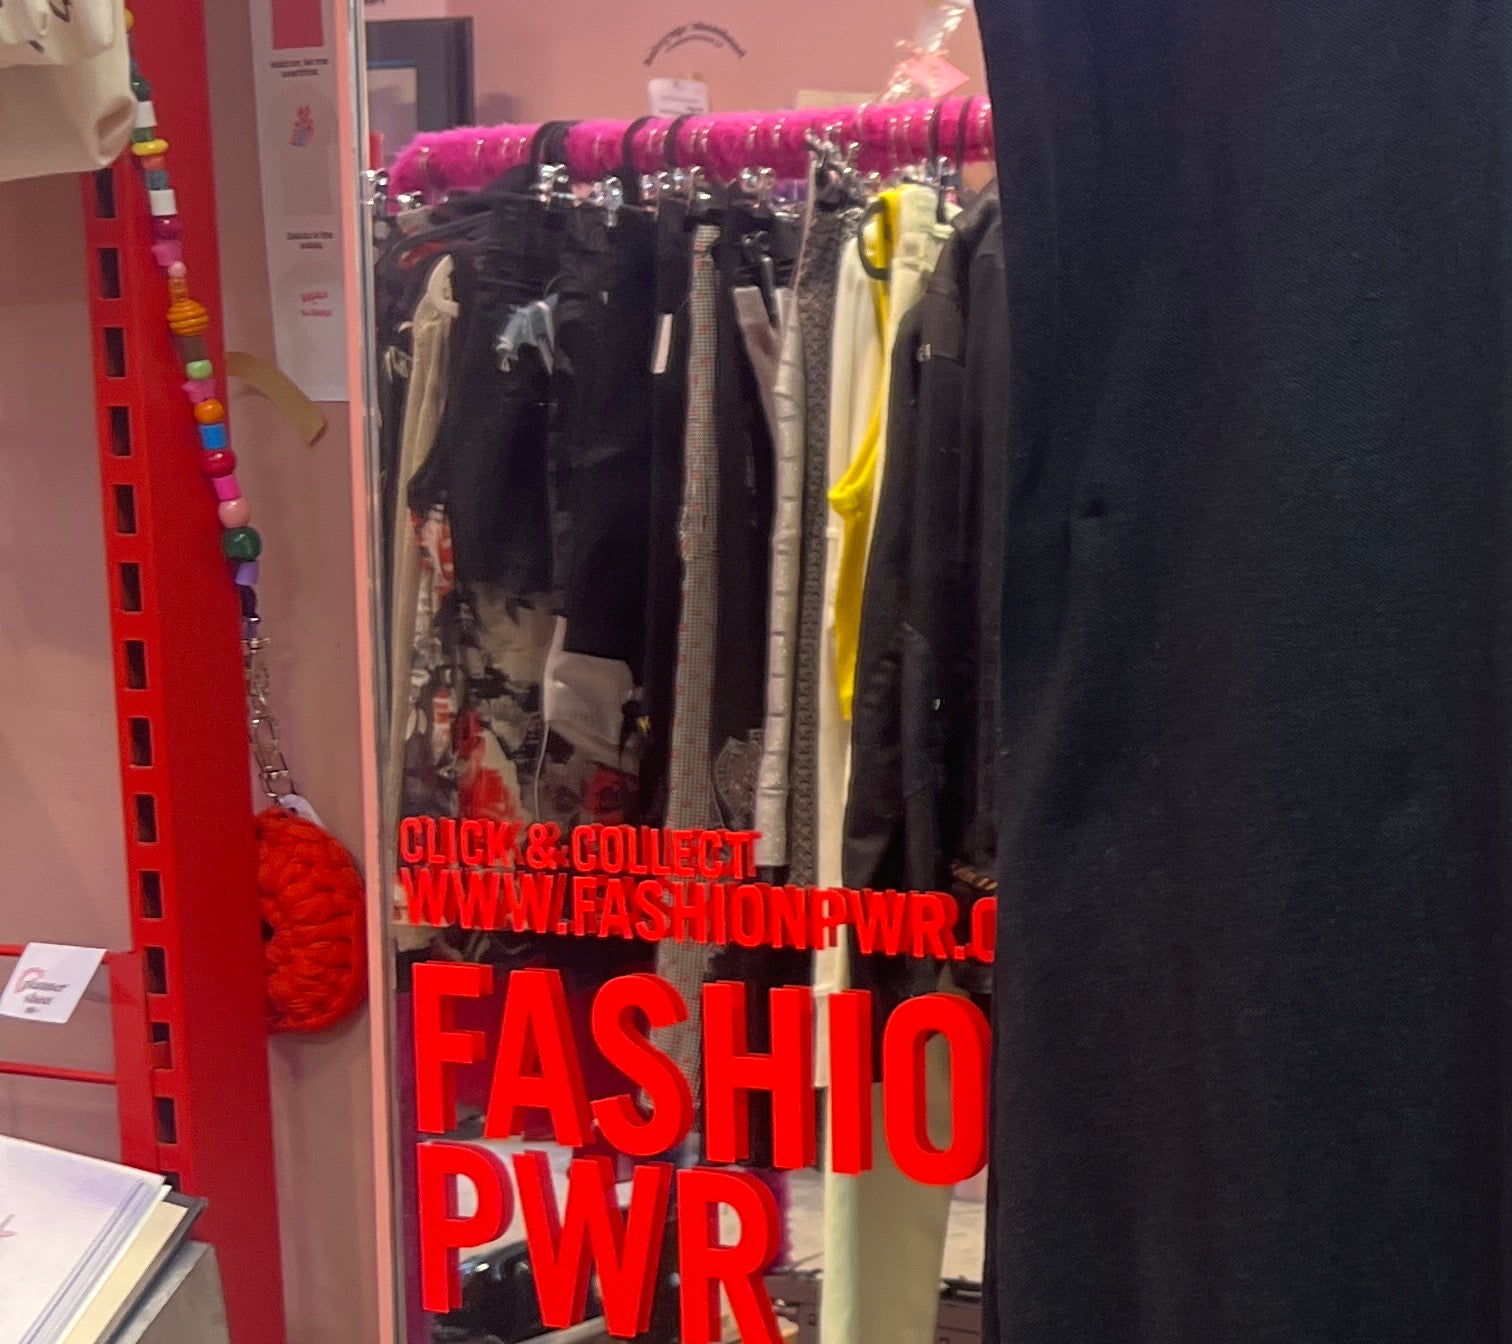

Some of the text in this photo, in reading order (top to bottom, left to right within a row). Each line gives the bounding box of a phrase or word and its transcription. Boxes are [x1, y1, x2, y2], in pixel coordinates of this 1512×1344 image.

[399, 816, 755, 879] CLICK & COLLECT
[400, 867, 998, 963] WWW.FASHIONPWR.C
[412, 961, 993, 1188] FASHIO
